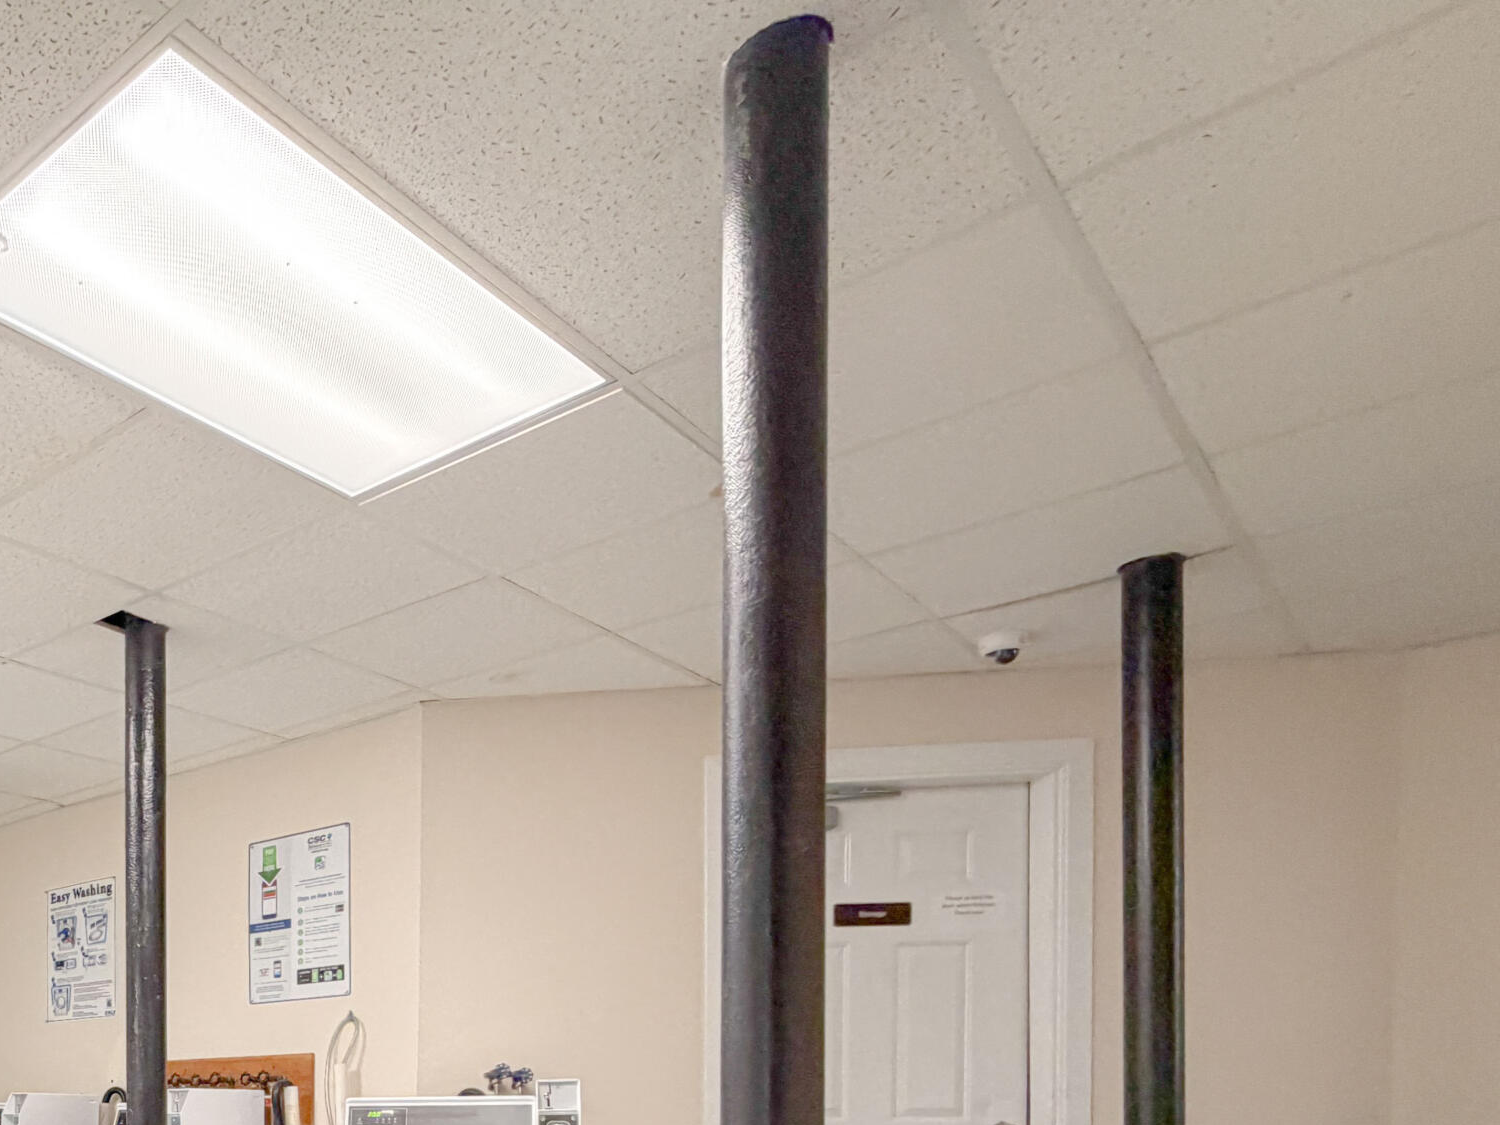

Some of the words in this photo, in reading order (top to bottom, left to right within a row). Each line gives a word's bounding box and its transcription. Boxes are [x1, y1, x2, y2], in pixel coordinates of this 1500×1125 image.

[307, 834, 327, 845] CSC
[50, 892, 71, 905] Easy
[73, 883, 113, 899] Washing
